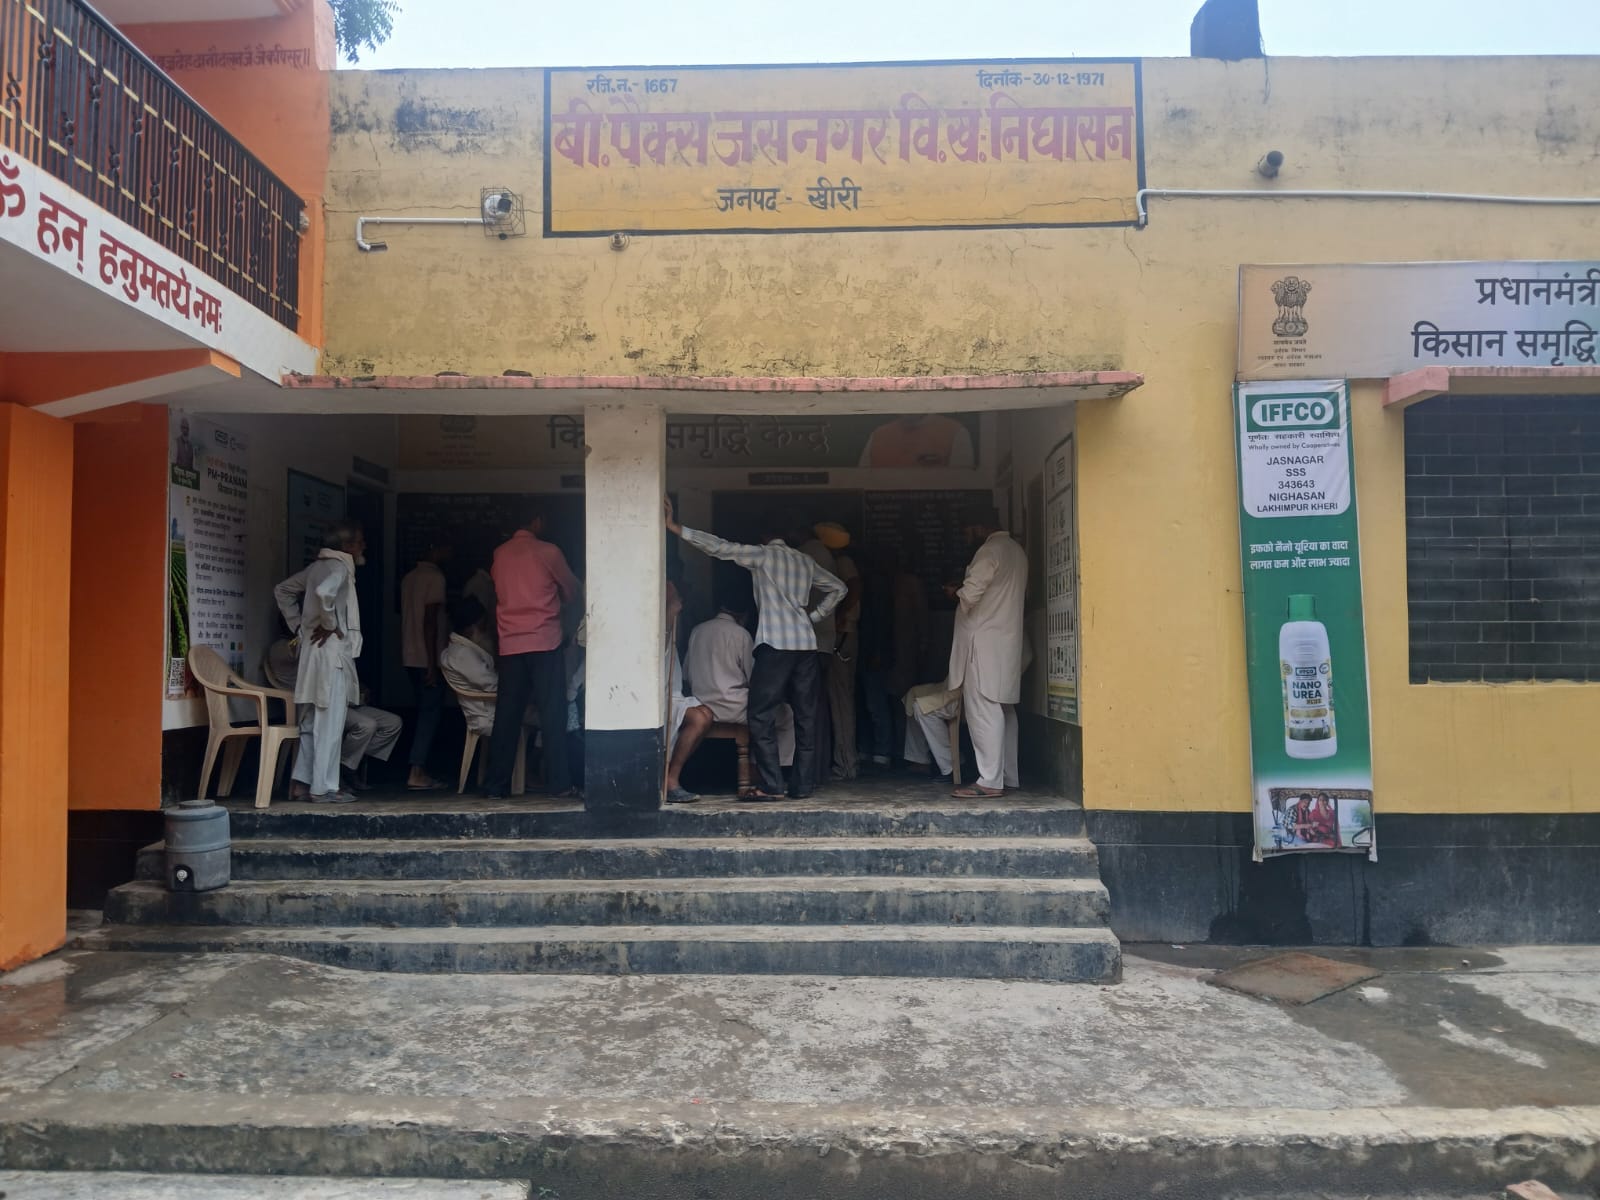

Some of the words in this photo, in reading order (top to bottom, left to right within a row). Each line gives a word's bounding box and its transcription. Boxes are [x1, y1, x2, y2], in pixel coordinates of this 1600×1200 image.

[644, 78, 679, 94] 1667
[710, 108, 890, 167] जसनगर
[99, 229, 192, 320] हनुमतये
[193, 286, 222, 334] नमः
[1411, 320, 1507, 358] किसान
[1514, 319, 1598, 366] समृद्धि
[1261, 402, 1326, 422] IFFCO
[1266, 455, 1324, 466] JASNAGAR
[1285, 467, 1306, 477] SSS
[1278, 479, 1315, 489] 343643
[1268, 491, 1325, 502] NIGHASAN
[1257, 503, 1309, 512] LAKHIMPUR
[1311, 502, 1338, 511] KHERI
[1319, 541, 1331, 552] का
[1273, 559, 1290, 569] कम
[1291, 556, 1307, 568] और
[1292, 681, 1322, 690] NANO
[1293, 689, 1322, 699] UREA
